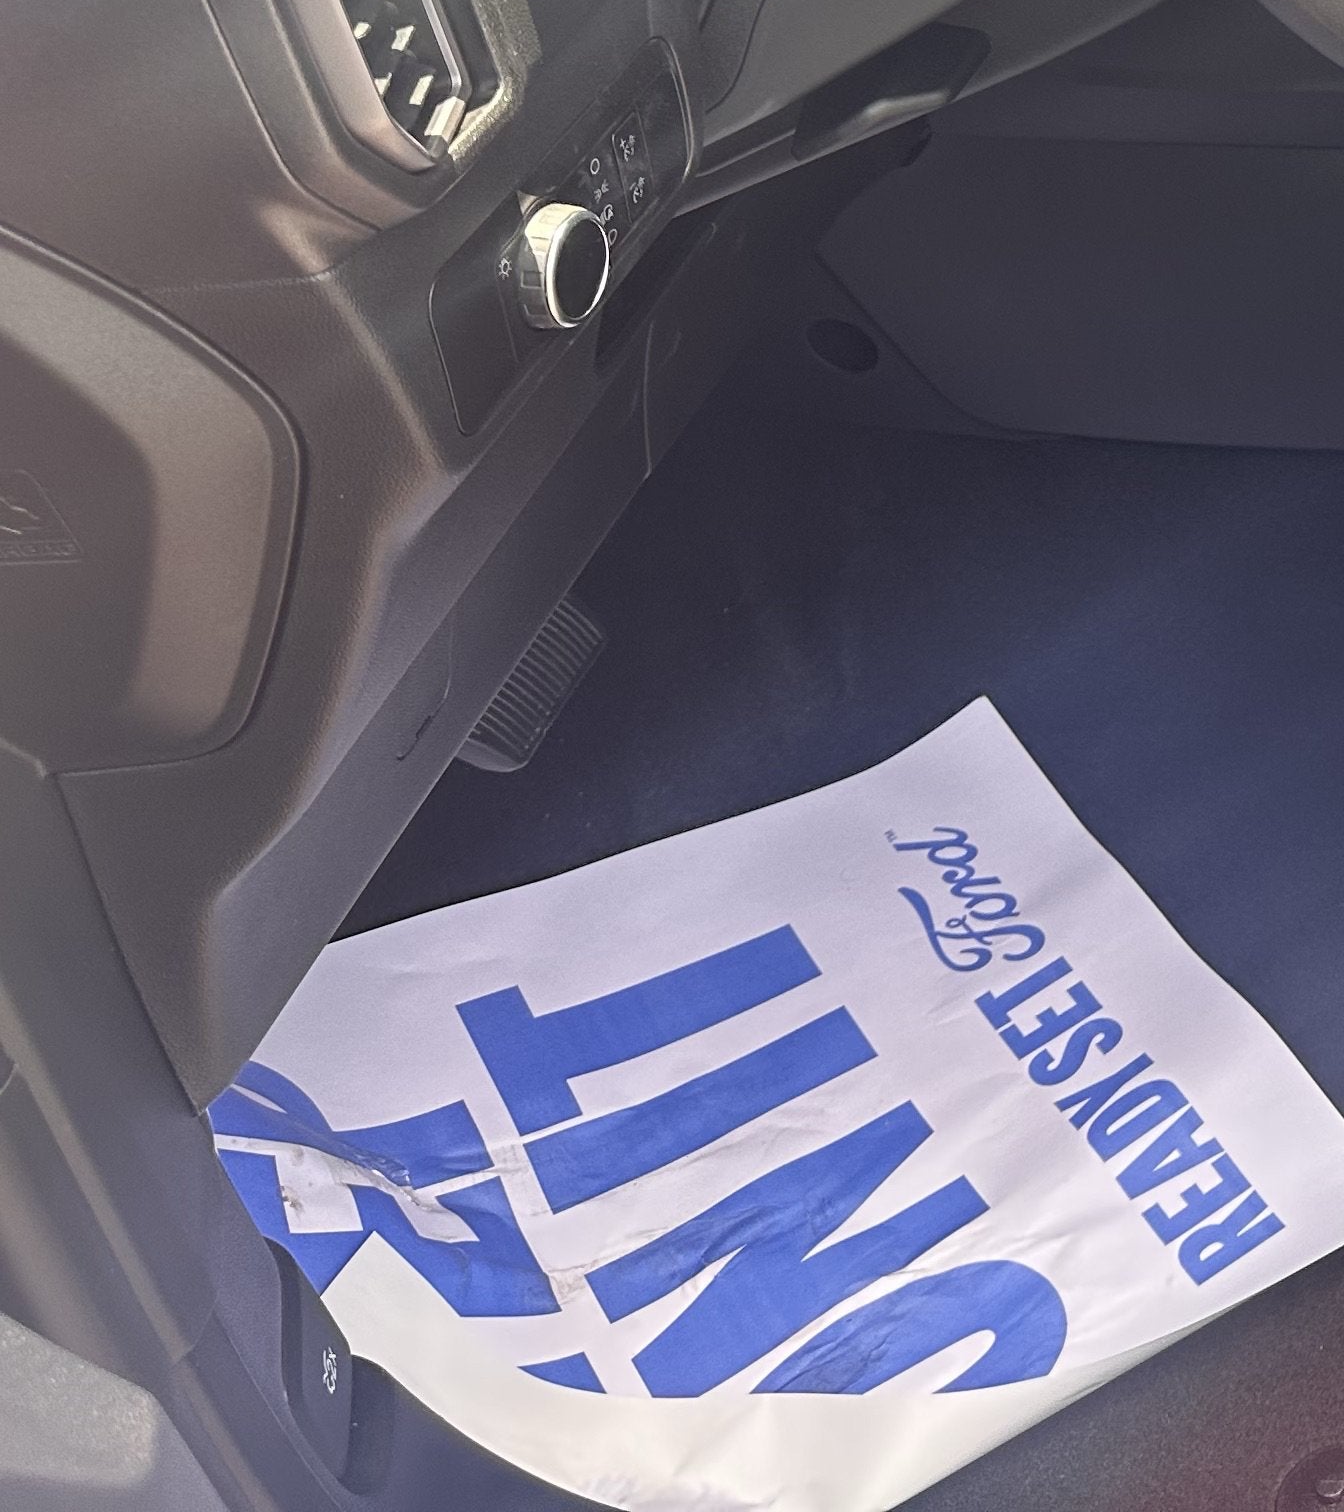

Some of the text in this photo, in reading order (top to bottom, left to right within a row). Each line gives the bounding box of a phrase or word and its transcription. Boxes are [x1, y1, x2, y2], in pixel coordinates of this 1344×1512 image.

[893, 825, 1047, 973] Ford
[973, 955, 1124, 1087] SET
[1053, 1051, 1286, 1287] READY
